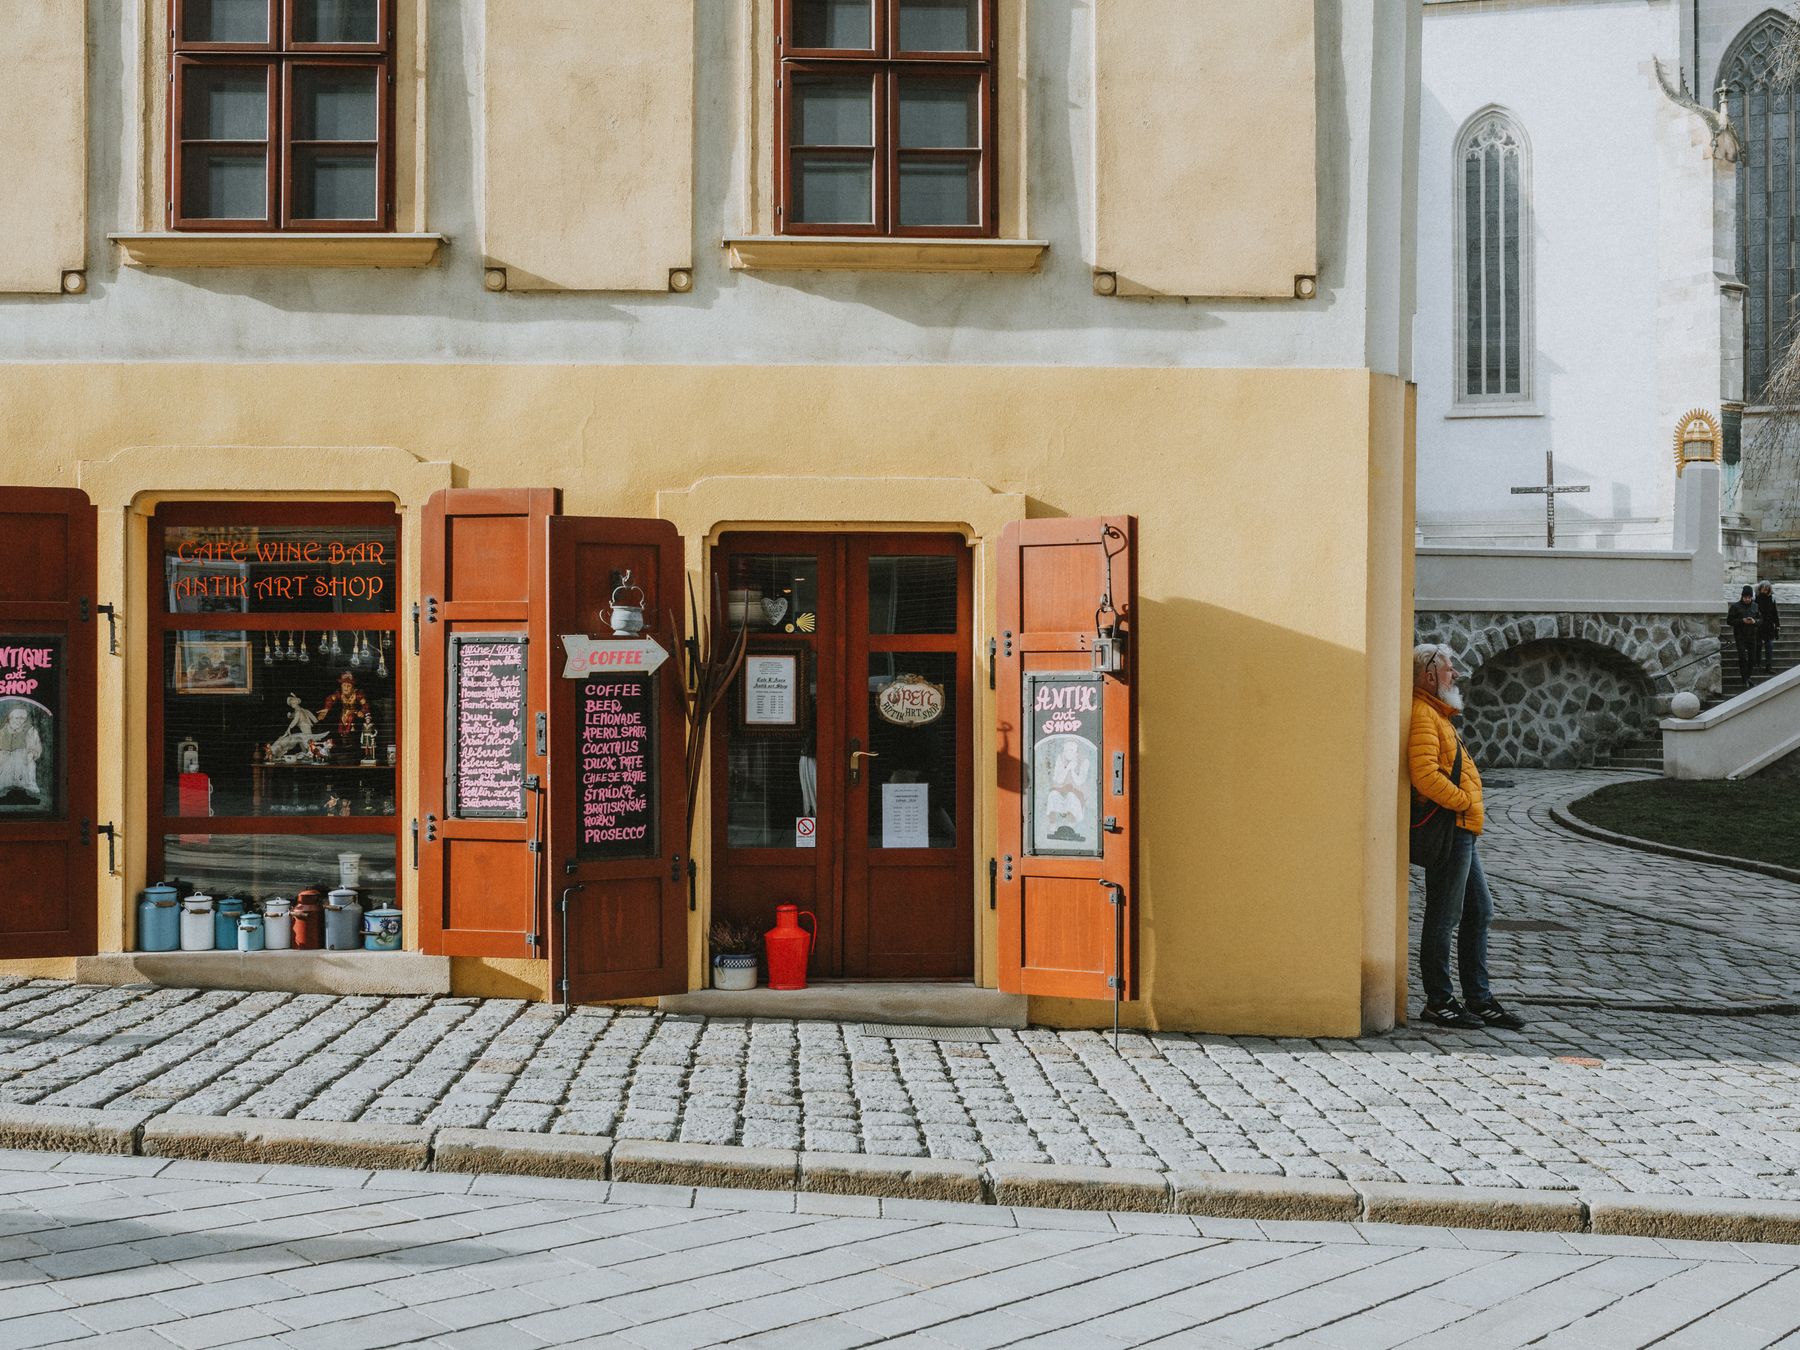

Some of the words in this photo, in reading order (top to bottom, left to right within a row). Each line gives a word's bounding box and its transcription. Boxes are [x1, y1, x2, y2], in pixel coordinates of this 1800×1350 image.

[178, 541, 249, 566] CAFE
[256, 541, 322, 563] WINE
[327, 541, 386, 566] BAR
[173, 575, 249, 600] ANTIK
[253, 575, 309, 600] ART
[313, 576, 383, 600] SHOP
[0, 646, 53, 670] NTIQUE
[589, 650, 643, 665] COFFEE
[5, 669, 26, 680] art
[585, 684, 641, 697] COFFEE
[585, 699, 622, 713] BEER
[1034, 685, 1098, 712] ANTIK
[461, 711, 496, 727] Dunaj
[585, 712, 641, 725] LEMONADE
[905, 708, 921, 717] ART
[922, 703, 940, 720] SHOP
[1052, 709, 1076, 720] art
[583, 726, 621, 742] APEROL
[1042, 720, 1082, 734] SHOP
[461, 745, 512, 759] Alibernet
[582, 740, 639, 756] COCKTAILS
[583, 756, 617, 770] DUCK
[583, 772, 620, 784] CHEESE
[621, 770, 647, 785] PLATE
[583, 793, 647, 816] BRATISLAVSKÉ
[584, 813, 615, 827] ROŽKY
[584, 824, 647, 843] PROSECCO
